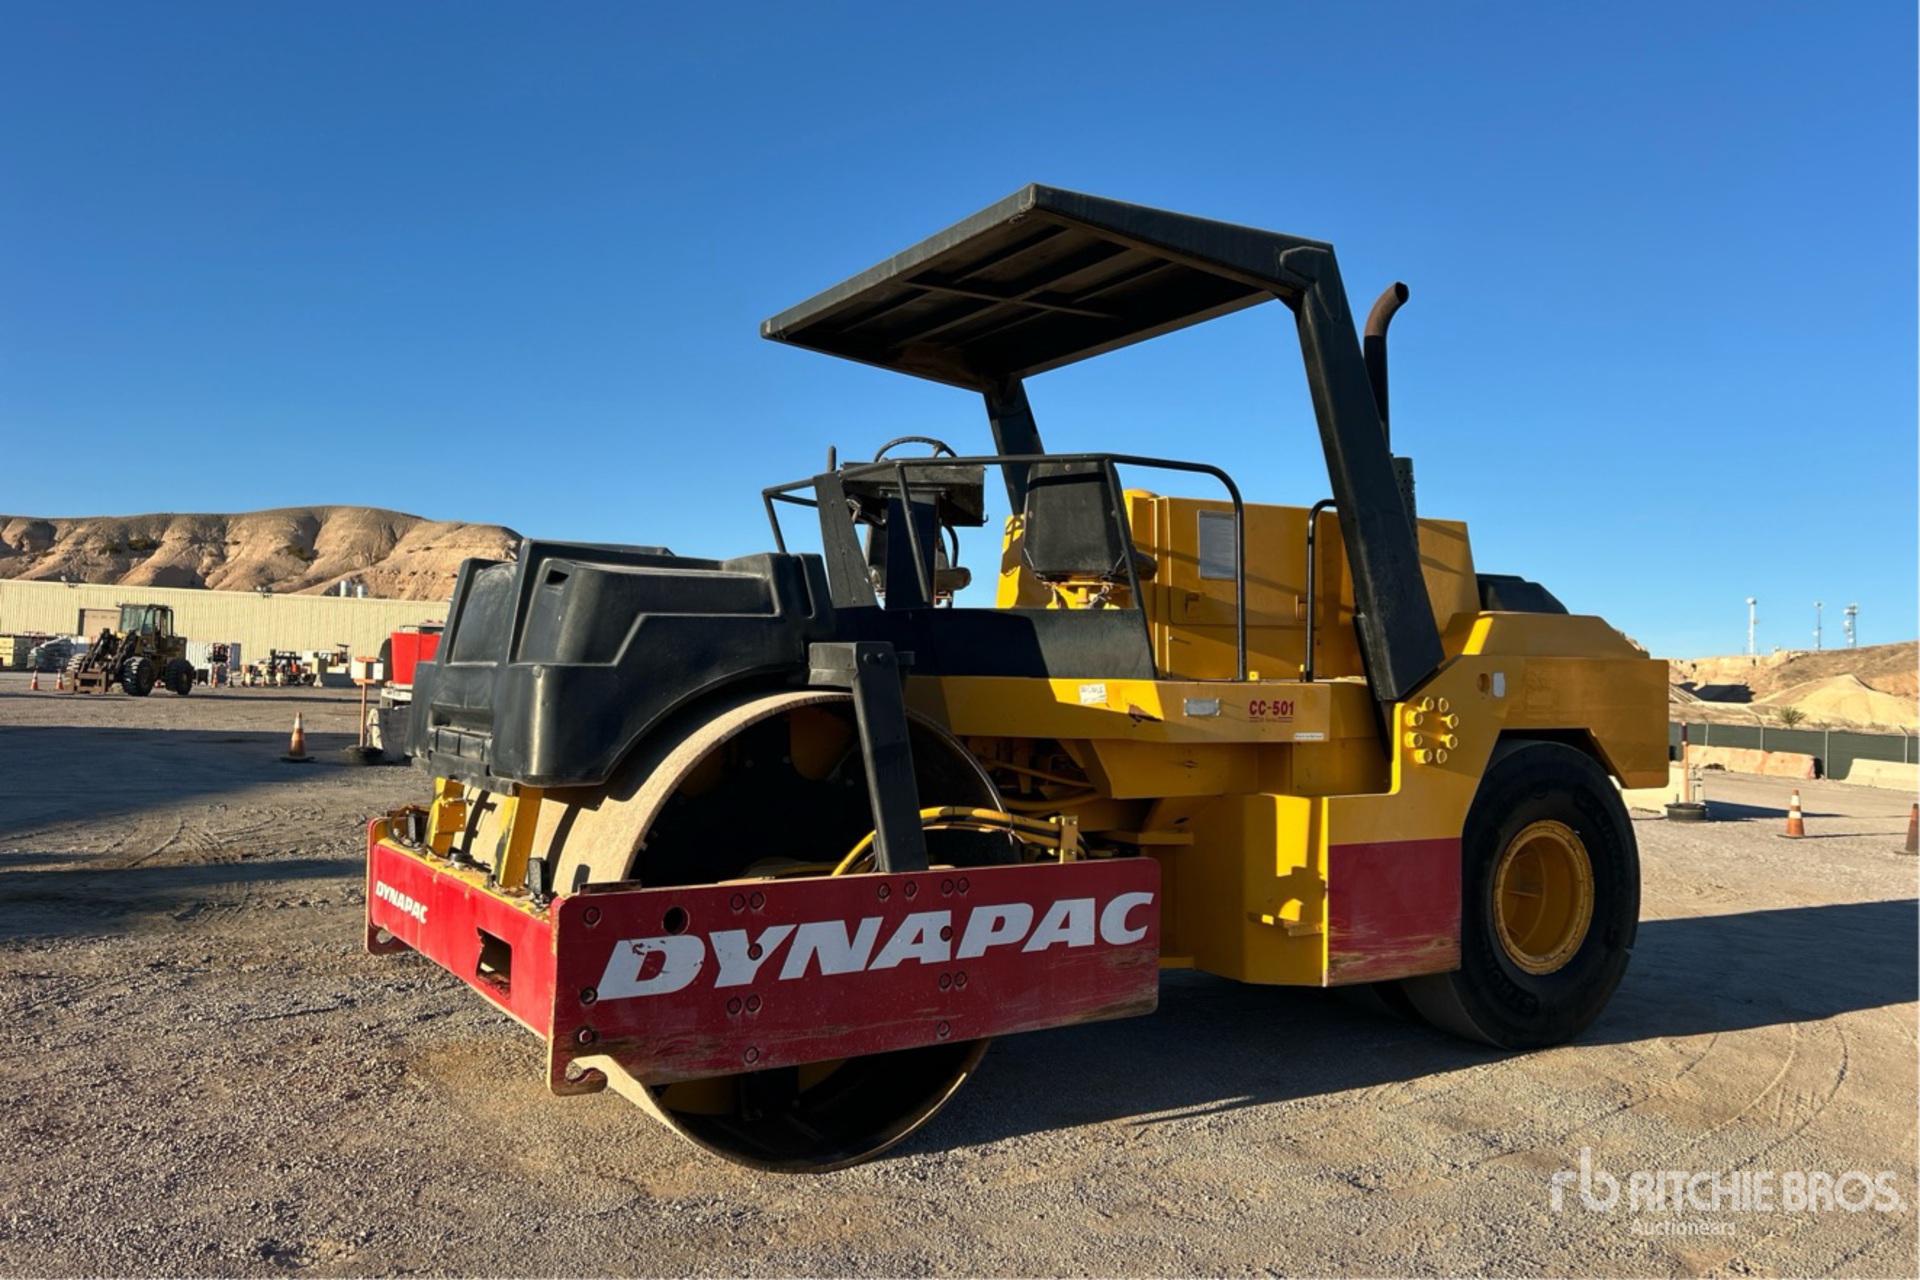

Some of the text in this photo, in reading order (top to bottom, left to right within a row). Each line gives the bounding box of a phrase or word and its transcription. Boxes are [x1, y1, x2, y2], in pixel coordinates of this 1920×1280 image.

[1249, 700, 1294, 716] CC-501
[375, 880, 428, 924] DYNAPAC
[596, 891, 1155, 1002] DYNAPAC
